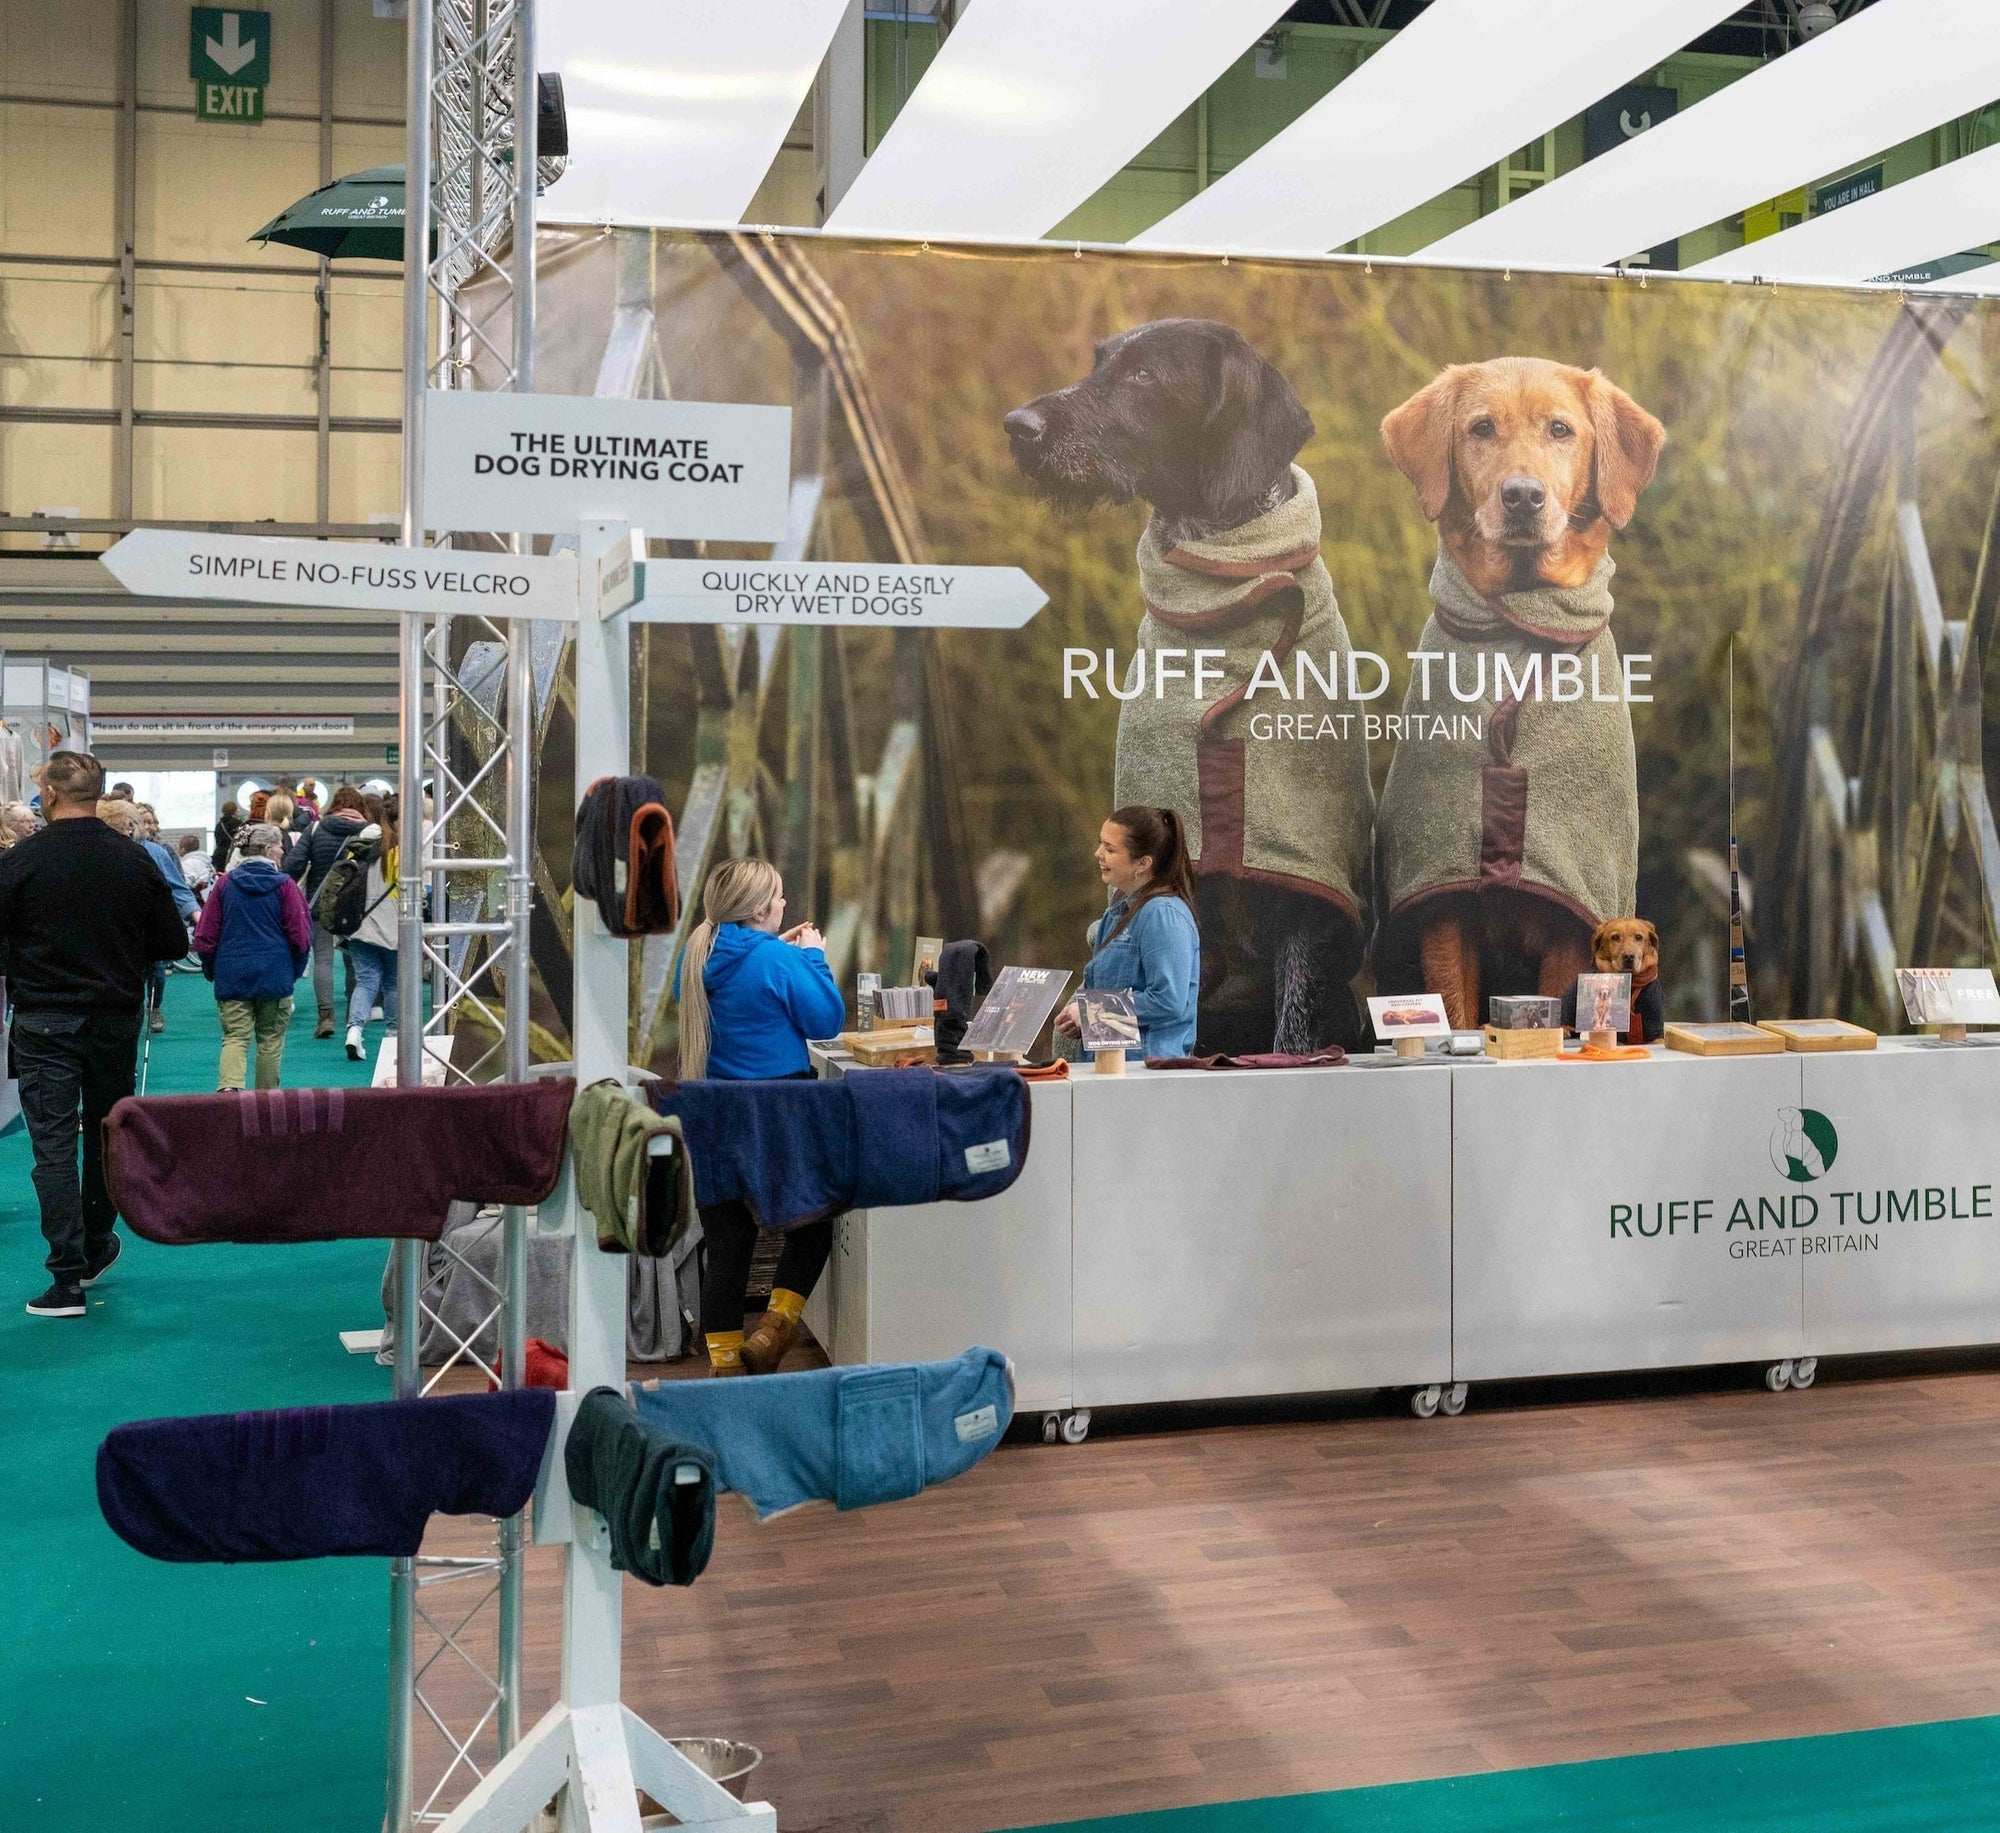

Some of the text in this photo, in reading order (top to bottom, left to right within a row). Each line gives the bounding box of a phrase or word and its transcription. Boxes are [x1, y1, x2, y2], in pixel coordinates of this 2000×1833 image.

[206, 84, 258, 116] EXIT
[1824, 181, 1875, 210] YOU ARE IN HALL
[1891, 272, 1931, 281] TUMBLE
[511, 432, 709, 460] THE ULTIMATE
[475, 454, 744, 483] DOG DRYING COAT
[189, 554, 530, 596] SIMPLE NO-FUSS VELCRO
[702, 571, 954, 595] QUICKLY AND EASILY
[736, 594, 923, 615] DRY WET DOGS
[1063, 648, 1655, 703] RUFF AND TUMBLE
[93, 722, 123, 731] Please
[127, 722, 139, 730] do
[162, 722, 173, 730] sit
[176, 722, 185, 730] in
[188, 722, 211, 731] front
[214, 722, 225, 730] of
[228, 722, 243, 730] the
[246, 723, 298, 732] emergency
[301, 722, 319, 730] exit
[321, 722, 348, 730] doors
[1250, 714, 1483, 741] GREAT BRITAIN
[1020, 969, 1050, 979] NEW
[1957, 988, 1994, 999] FREE
[1610, 1184, 1993, 1238] RUFF AND TUMBLE
[1729, 1233, 1880, 1259] GREAT BRITAIN
